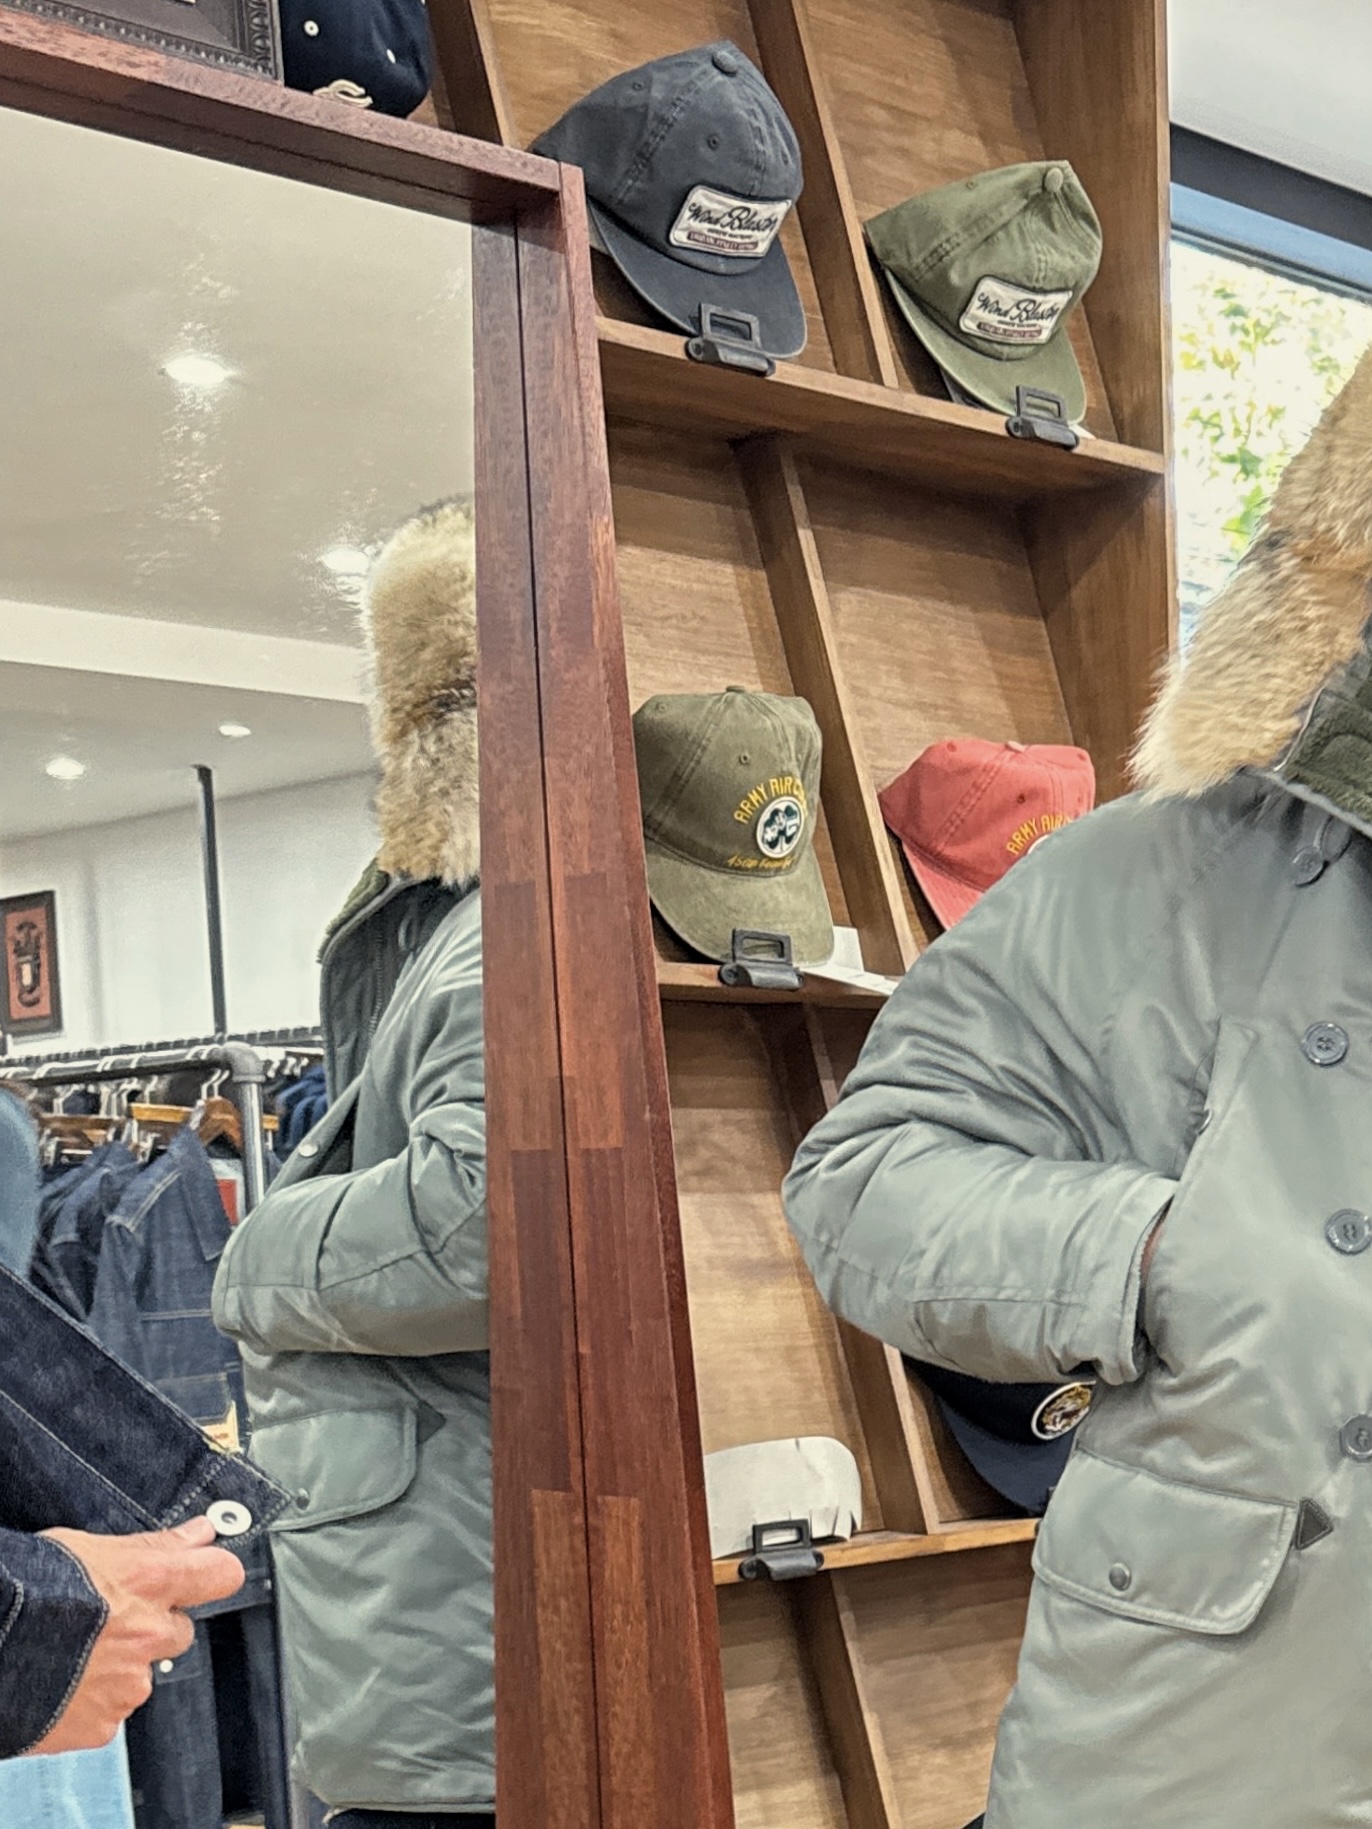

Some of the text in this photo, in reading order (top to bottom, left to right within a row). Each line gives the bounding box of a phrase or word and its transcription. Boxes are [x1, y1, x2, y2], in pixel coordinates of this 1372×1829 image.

[688, 202, 727, 226] Wind
[977, 292, 1017, 318] Wind
[733, 782, 769, 825] ARMY
[769, 776, 793, 797] AIR
[1006, 817, 1038, 856] ARMY
